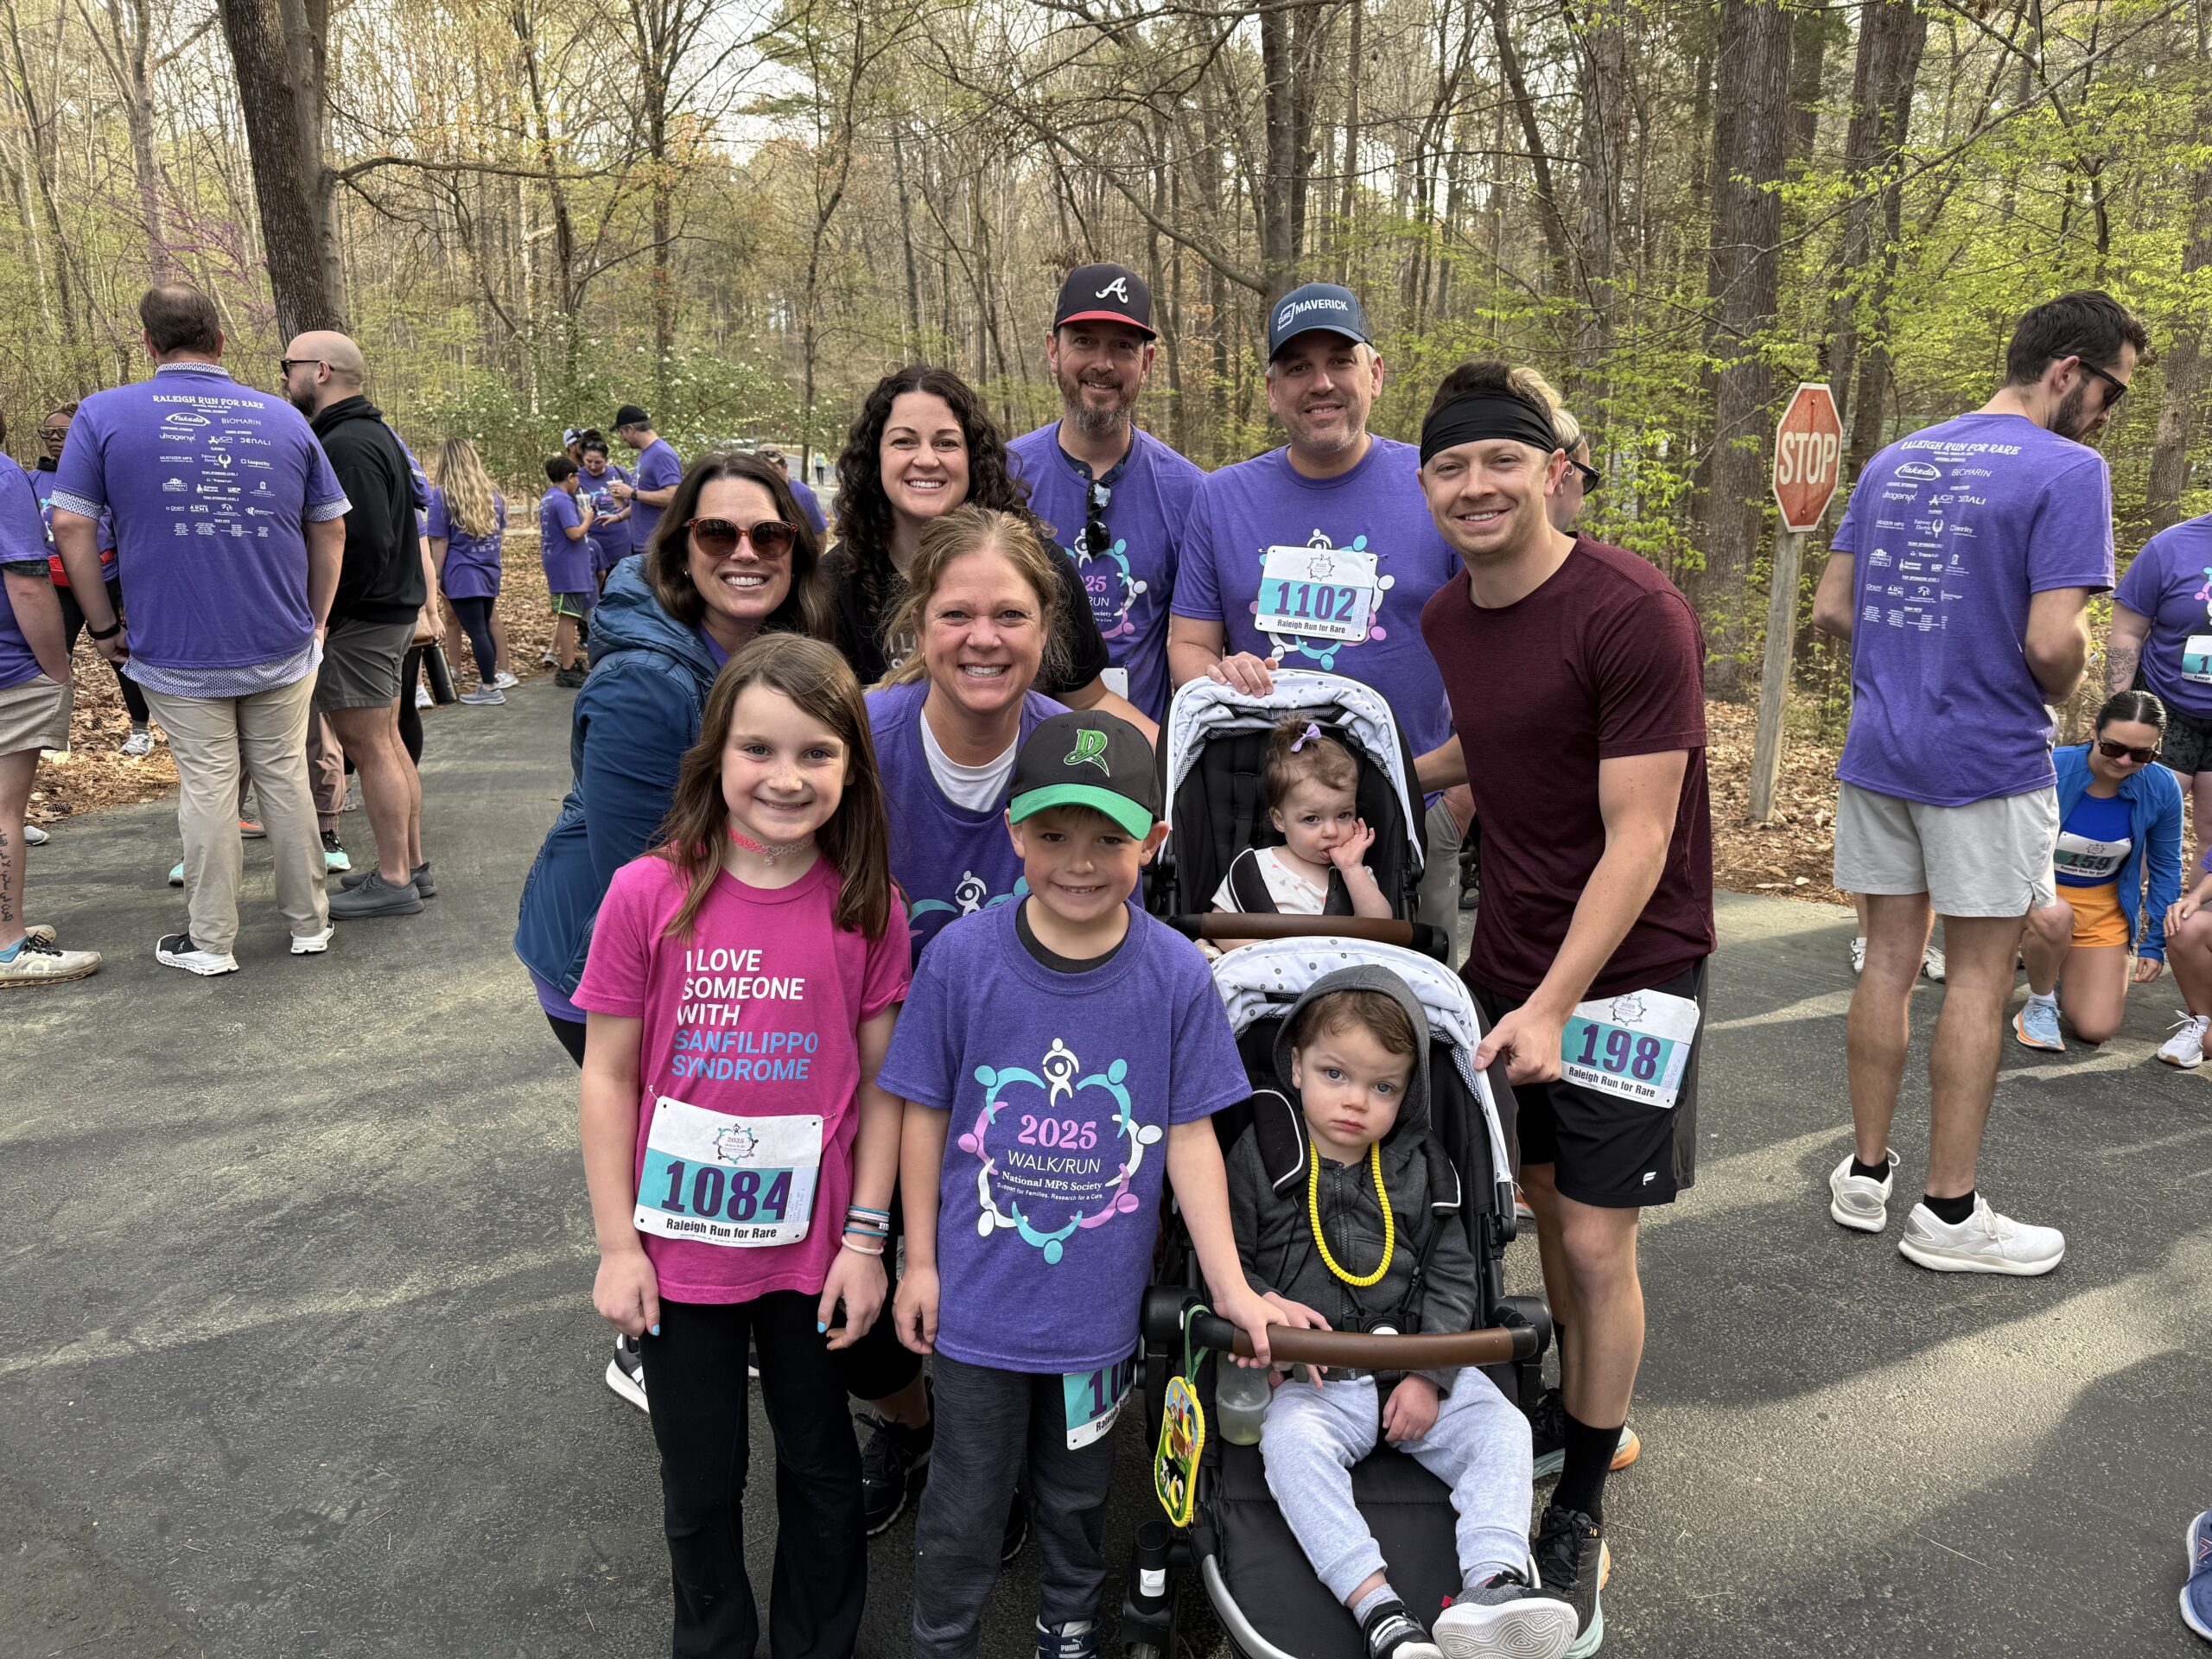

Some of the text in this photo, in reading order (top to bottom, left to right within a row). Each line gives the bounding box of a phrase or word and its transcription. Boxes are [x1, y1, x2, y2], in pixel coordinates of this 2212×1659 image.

[1295, 298, 1348, 315] MAVERICK
[153, 395, 196, 404] RALEIGH
[198, 397, 218, 405] RUN
[220, 398, 240, 407] FOR
[241, 399, 265, 410] RARE
[1779, 431, 1837, 485] STOP
[1900, 440, 2021, 455] RALEIGH RUN FOR RARE
[1901, 466, 1936, 475] Takeda
[1081, 575, 1107, 592] 25
[1274, 582, 1357, 621] 1102
[1277, 619, 1345, 634] Raleigh Run for Rare
[2066, 853, 2111, 871] 159
[685, 949, 762, 972] I LOVE
[682, 977, 805, 1001] SOMEONE
[677, 1003, 741, 1027] WITH
[673, 1029, 818, 1053] SANFILIPPO
[1577, 1023, 1661, 1081] 198
[672, 1054, 810, 1080] SYNDROME
[1568, 1066, 1656, 1097] Raleigh Run for Rare
[1018, 1114, 1097, 1150] 2025
[1008, 1149, 1101, 1174] WALK/RUN
[660, 1160, 794, 1223] 1084
[996, 1182, 1016, 1192] Support
[1002, 1170, 1103, 1192] National MPS Society
[666, 1218, 777, 1238] Raleigh Run for Rare
[1060, 1643, 1079, 1652] PUMA
